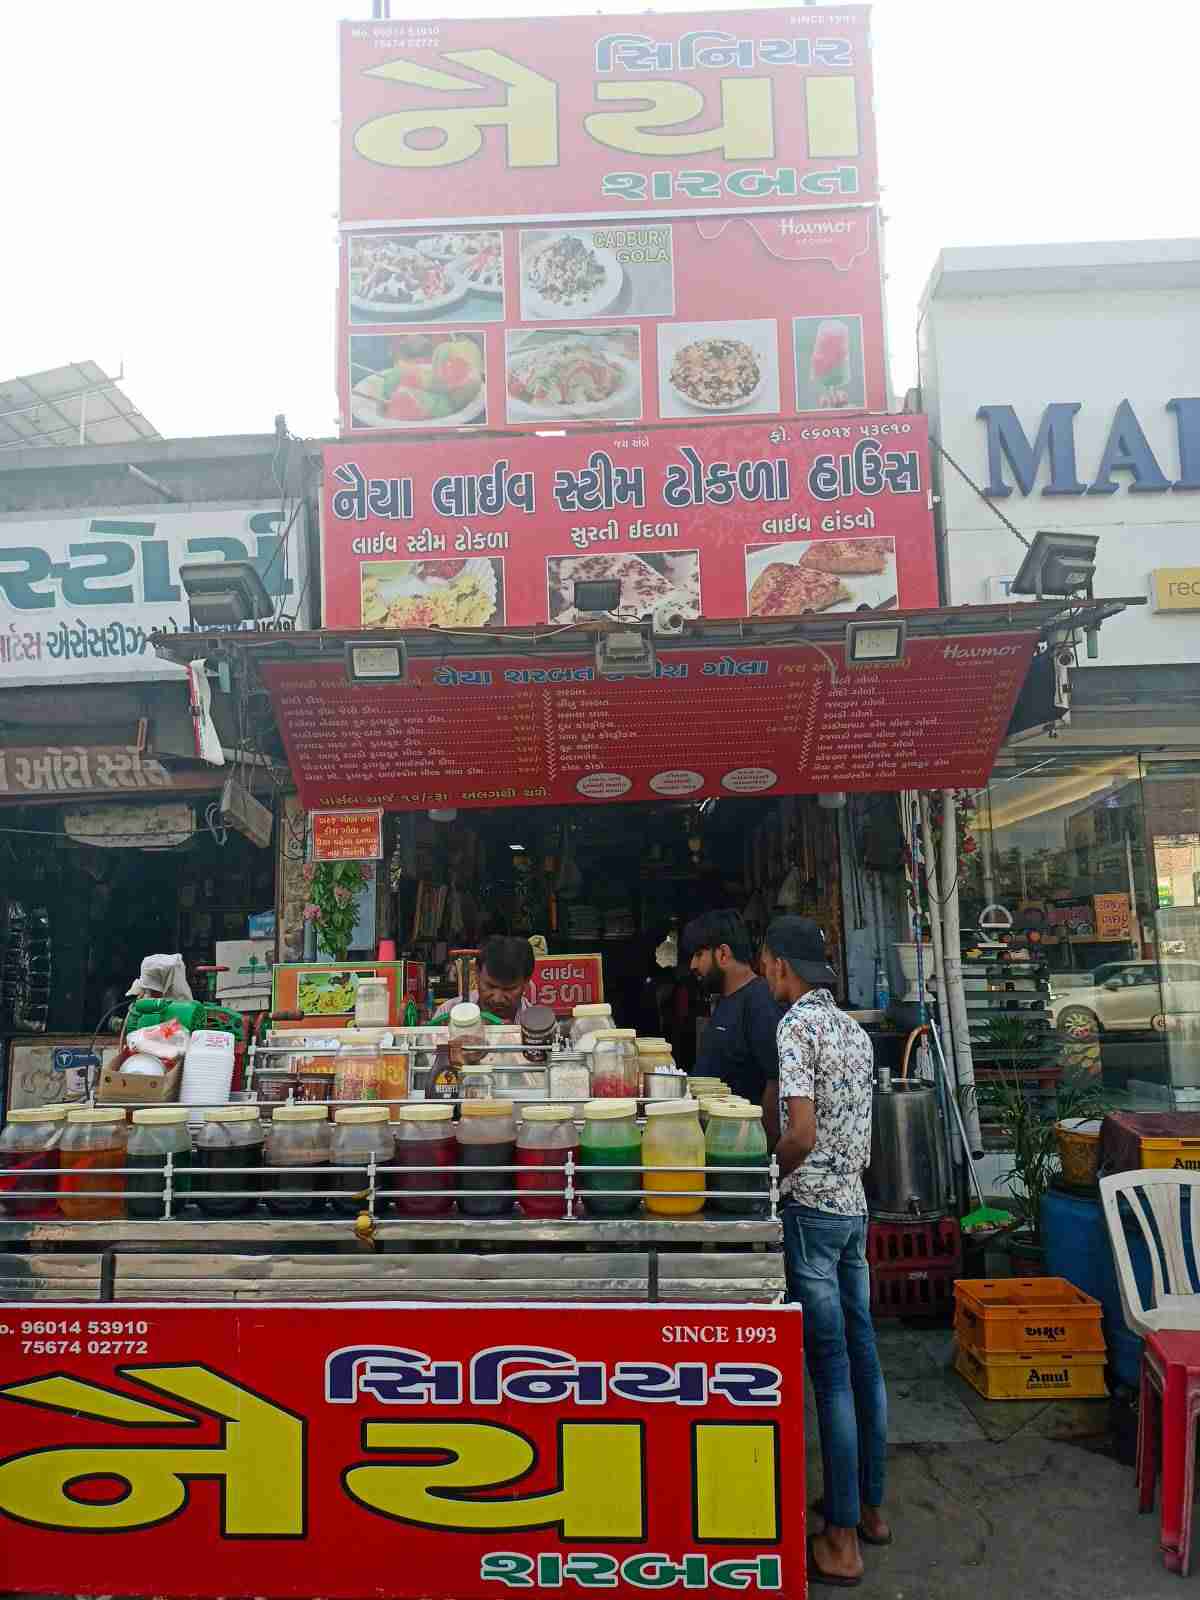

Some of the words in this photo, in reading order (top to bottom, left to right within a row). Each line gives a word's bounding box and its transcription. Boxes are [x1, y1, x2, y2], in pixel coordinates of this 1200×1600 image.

[594, 31, 854, 73] સિનિયર
[601, 166, 859, 201] શરબત
[592, 229, 672, 249] CADBURY
[615, 248, 672, 264] GOLA
[431, 459, 536, 517] લાઈવ
[553, 450, 646, 511] સ્ટીમ
[663, 446, 790, 508] ઢોકળા
[808, 438, 921, 501] હાઉસ
[21, 1320, 82, 1336] 96014
[87, 1320, 149, 1336] 53910
[661, 1325, 730, 1344] SINCE
[734, 1325, 778, 1344] 1993
[21, 1340, 82, 1355] 75674
[87, 1340, 149, 1355] 02772
[324, 1344, 783, 1406] સિનિયર
[1027, 1368, 1069, 1385] Amul
[480, 1551, 783, 1591] શરબત
